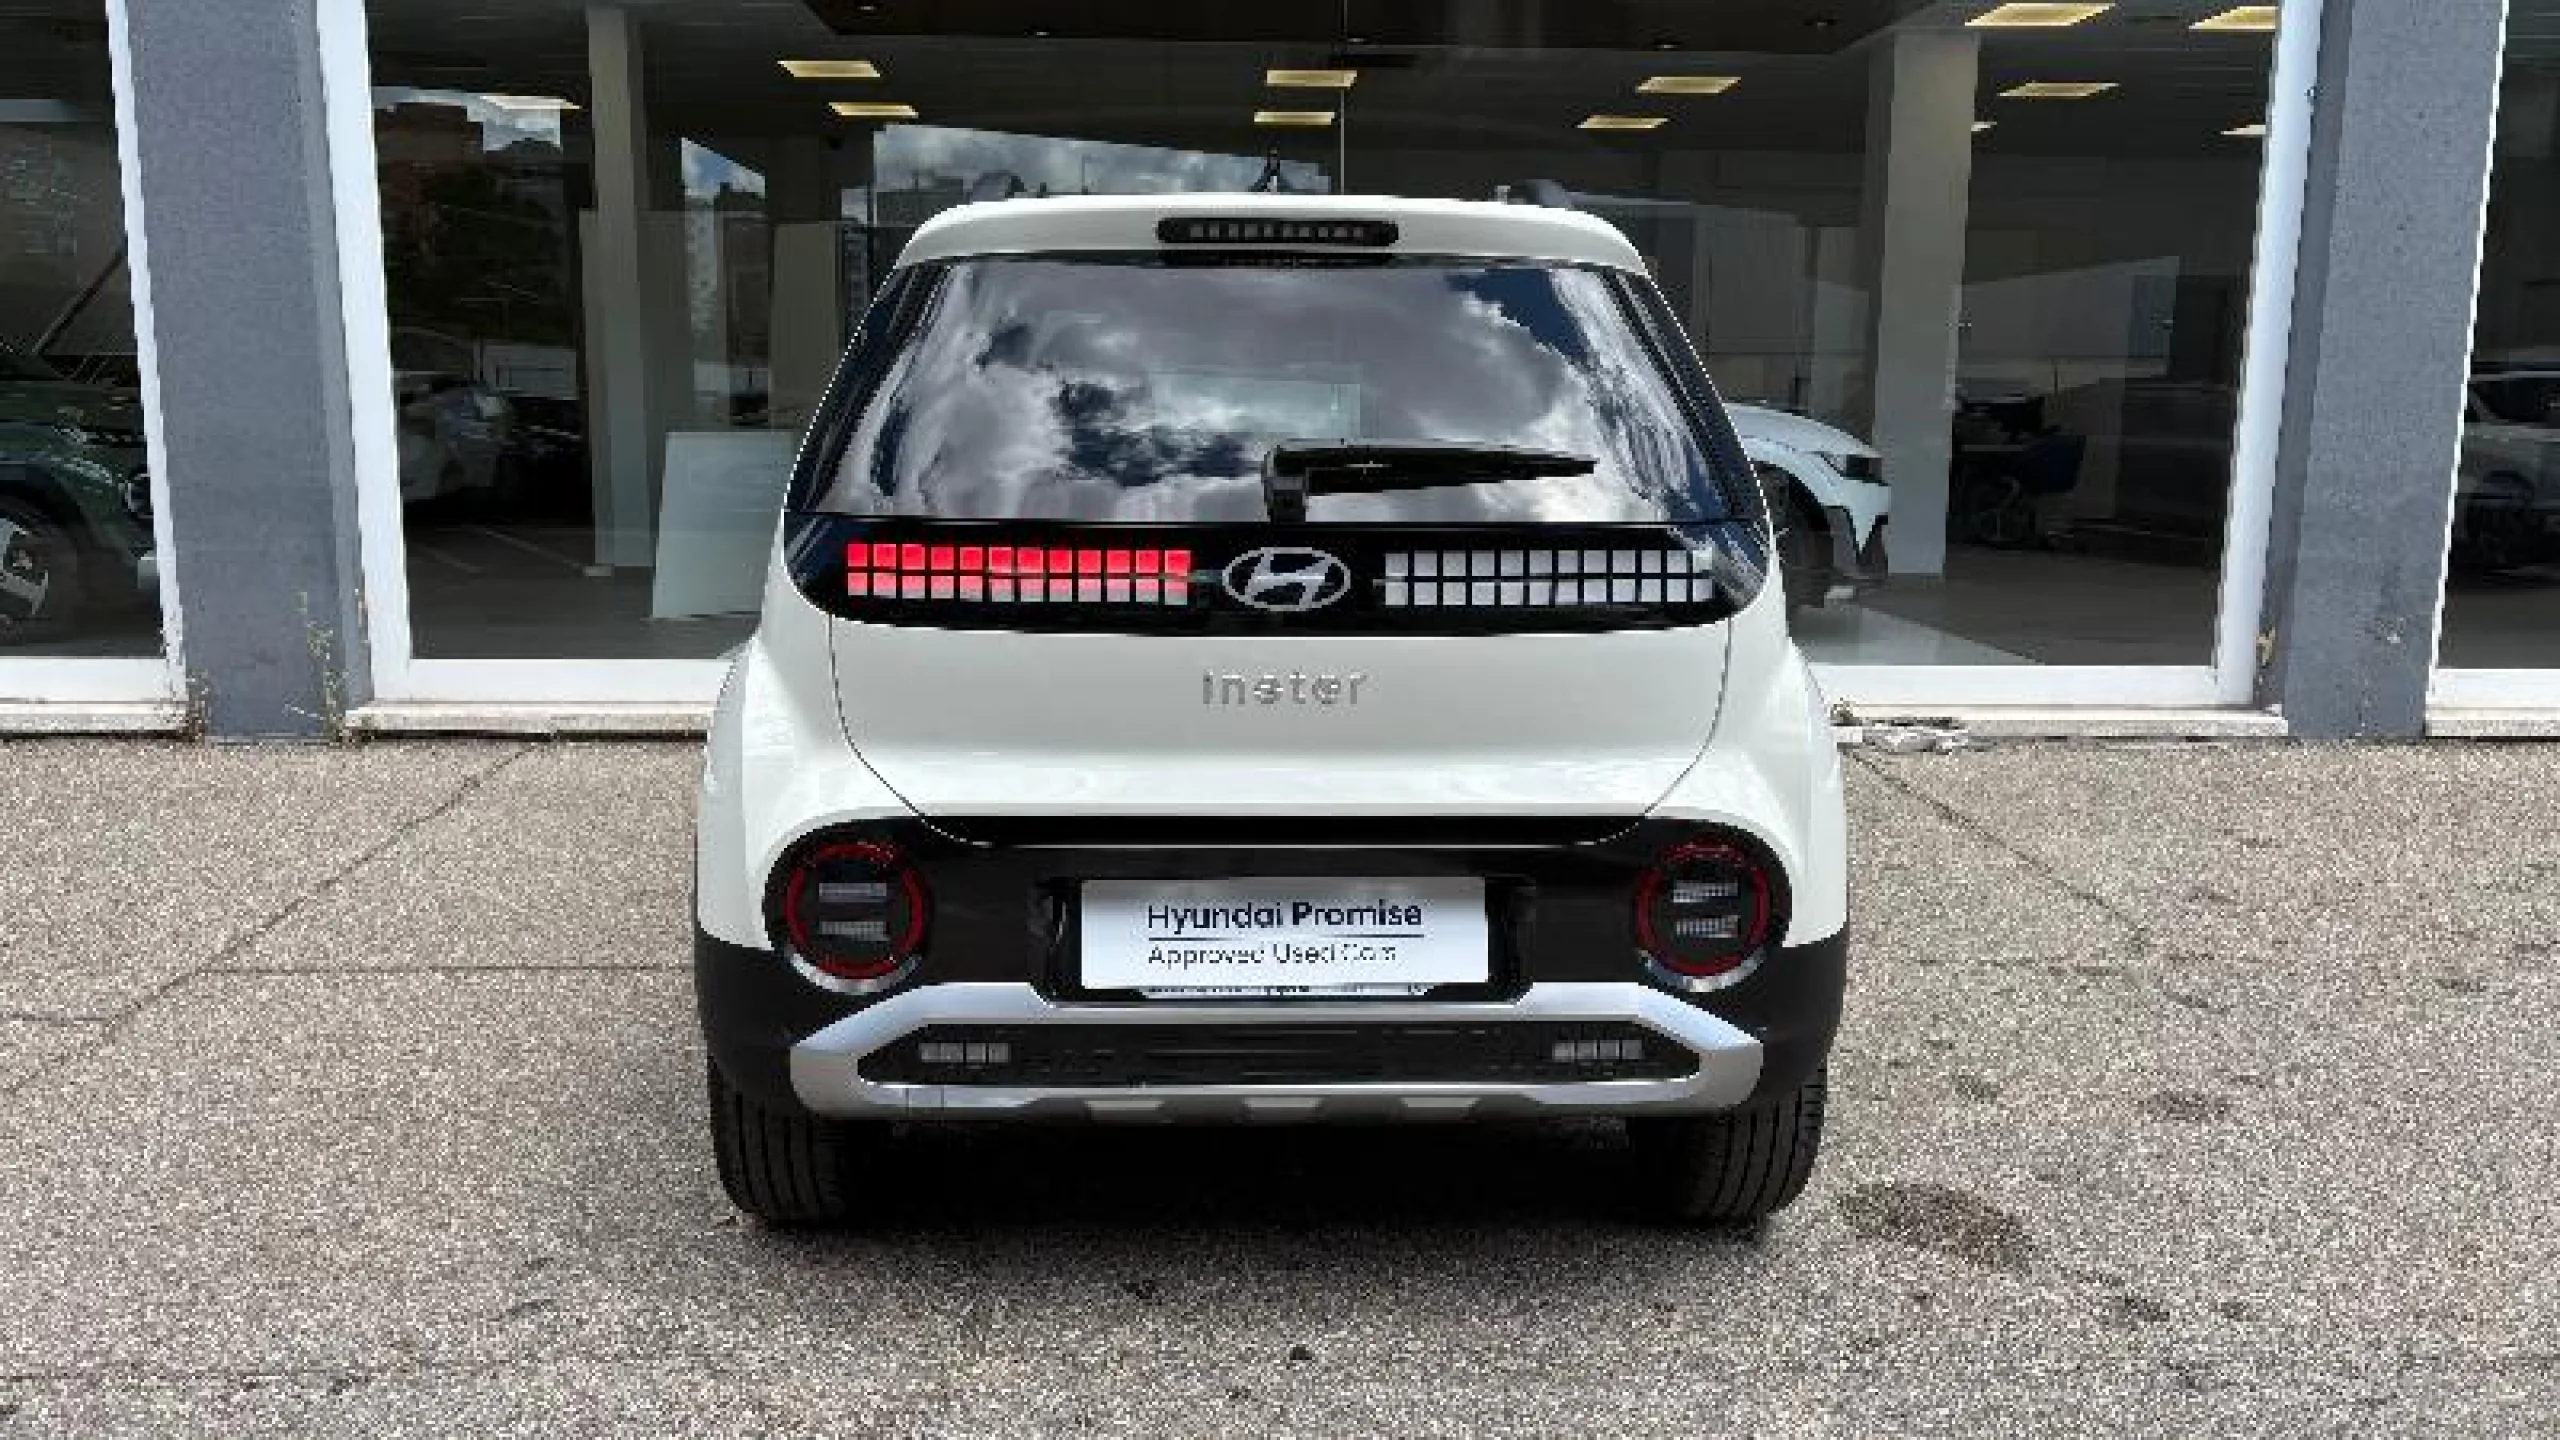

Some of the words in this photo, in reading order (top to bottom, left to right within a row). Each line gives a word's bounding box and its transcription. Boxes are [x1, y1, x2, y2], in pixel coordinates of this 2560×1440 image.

[1148, 901, 1284, 934] Hyundai
[1291, 899, 1422, 927] Promise
[1148, 942, 1266, 970] Approved
[1273, 943, 1335, 964] Used
